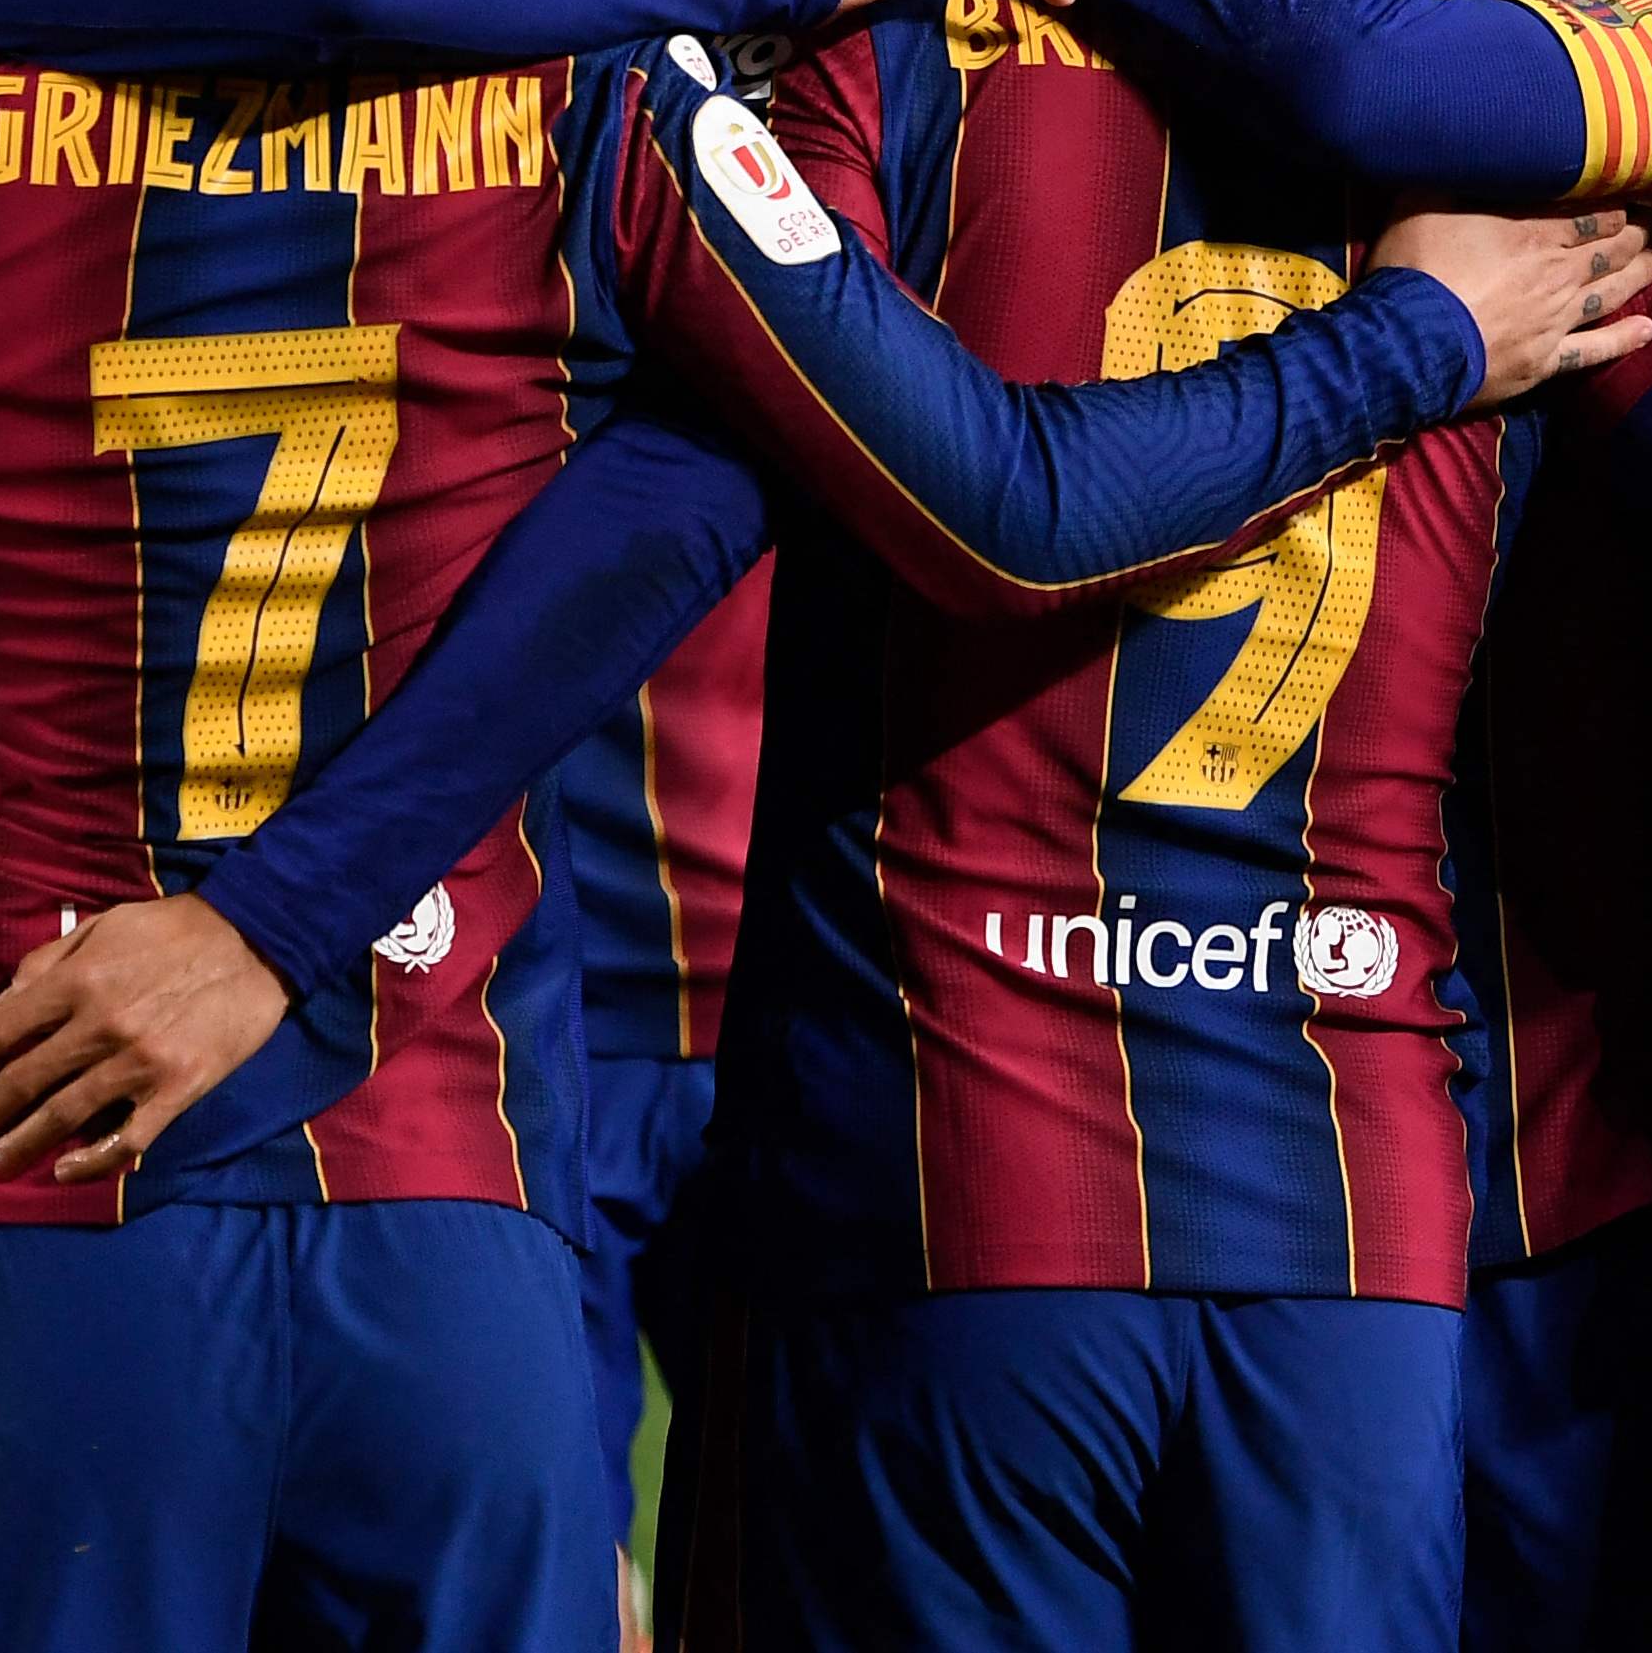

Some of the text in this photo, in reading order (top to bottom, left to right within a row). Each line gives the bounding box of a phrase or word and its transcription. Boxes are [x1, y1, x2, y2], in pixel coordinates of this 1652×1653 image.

[90, 323, 403, 842] 7
[1101, 240, 1389, 811] 9
[985, 895, 1293, 993] unicef
